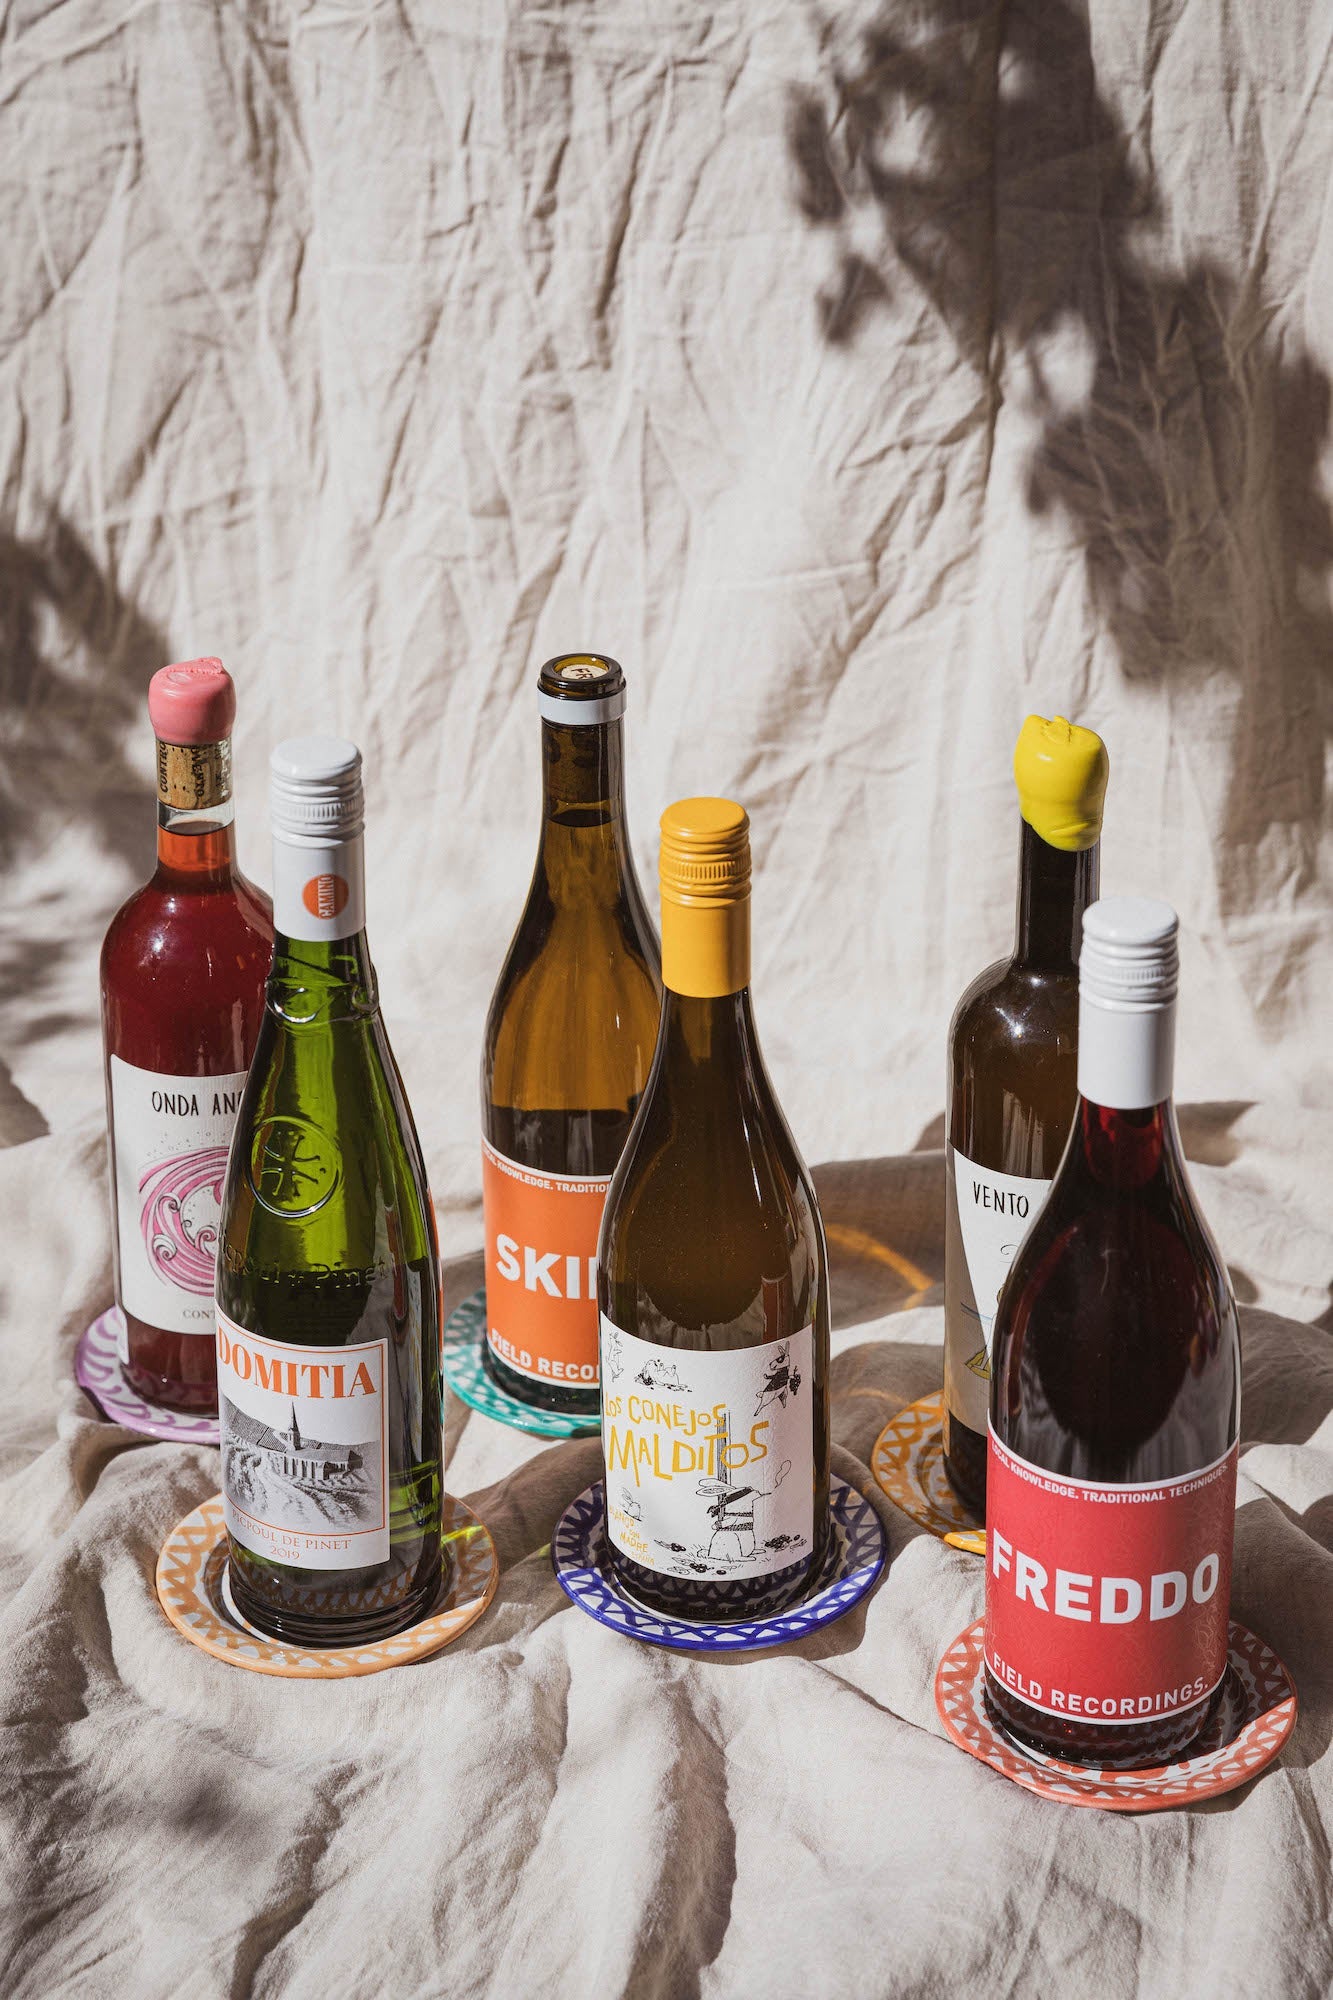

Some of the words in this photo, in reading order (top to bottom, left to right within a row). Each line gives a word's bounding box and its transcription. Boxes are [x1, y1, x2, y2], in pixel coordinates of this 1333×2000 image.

[317, 875, 335, 919] CAMINO
[152, 1091, 199, 1116] ONDA
[497, 1160, 554, 1190] KNOWLEDGE.
[973, 1181, 1029, 1218] VENTO
[219, 1325, 378, 1399] DOMITIA
[491, 1328, 532, 1368] FIELD
[538, 1357, 599, 1380] RECO
[628, 1395, 727, 1436] CONEJOS
[608, 1421, 770, 1487] MALDITOS
[1010, 1462, 1079, 1499] KNOWLEDGE.
[1082, 1489, 1166, 1504] TRADITIONAL
[232, 1509, 278, 1542] PICPOUL
[282, 1535, 301, 1547] DE
[305, 1539, 352, 1550] PINET
[270, 1546, 300, 1560] 2019
[992, 1528, 1220, 1624] FREDDO
[993, 1652, 1042, 1699] FIELD
[1051, 1676, 1209, 1716] RECORDINGS.
